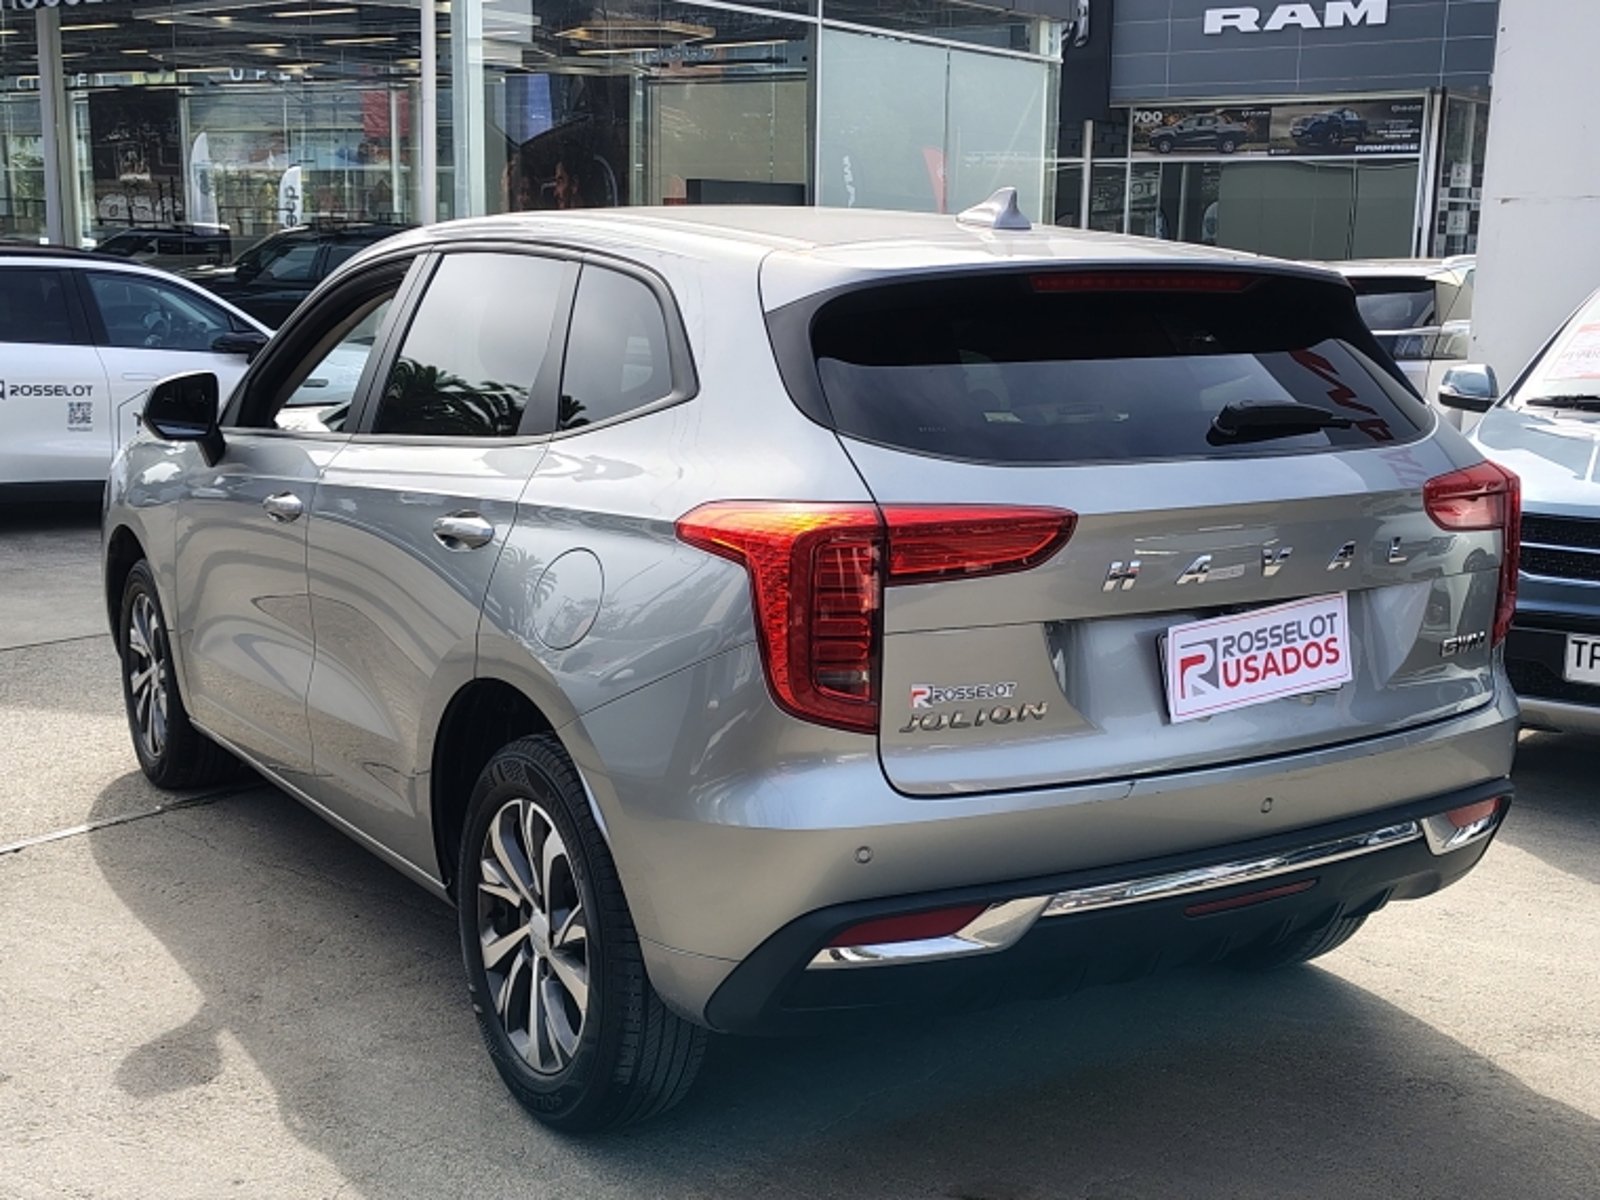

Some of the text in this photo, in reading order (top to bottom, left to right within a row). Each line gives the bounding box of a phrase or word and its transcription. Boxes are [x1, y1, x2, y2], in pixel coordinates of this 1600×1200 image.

[1203, 0, 1388, 35] RAM
[10, 385, 93, 397] ROSSELOT
[1102, 537, 1408, 592] HAVAL
[1222, 613, 1338, 659] ROSSELOT
[1221, 637, 1341, 688] USADOS
[933, 683, 1017, 702] ROSSELOT
[899, 702, 1048, 733] JOLION
